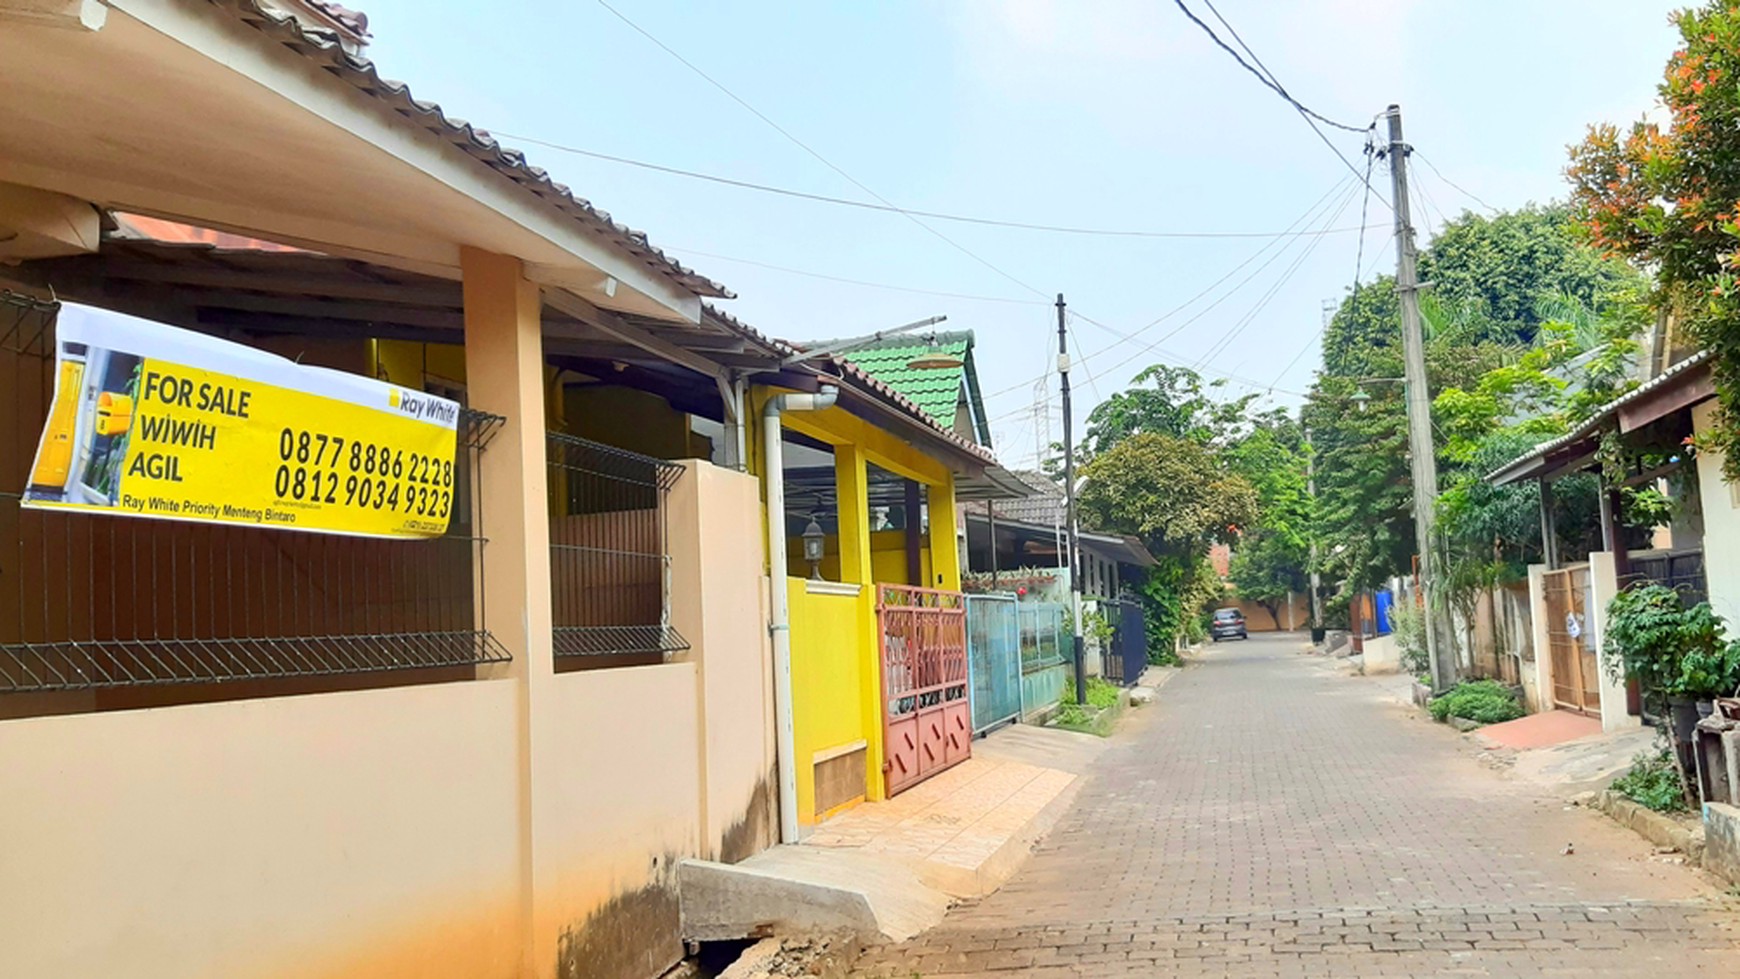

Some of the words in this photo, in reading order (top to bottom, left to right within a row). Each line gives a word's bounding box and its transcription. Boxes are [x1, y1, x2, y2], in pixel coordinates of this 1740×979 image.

[144, 371, 193, 408] FOR
[196, 382, 251, 418] SALE
[400, 390, 426, 418] Ray
[426, 397, 455, 423] White
[128, 452, 183, 482] AGIL
[280, 427, 344, 468] 0877
[350, 441, 402, 479] 8886
[408, 453, 452, 488] 2228
[123, 494, 145, 510] Ray
[149, 497, 179, 512] White
[182, 500, 220, 518] Priority
[222, 504, 262, 522] Menteng
[265, 508, 296, 523] Bintaro
[275, 464, 338, 504] 0812
[345, 475, 400, 511] 9034
[404, 485, 450, 518] 9323
